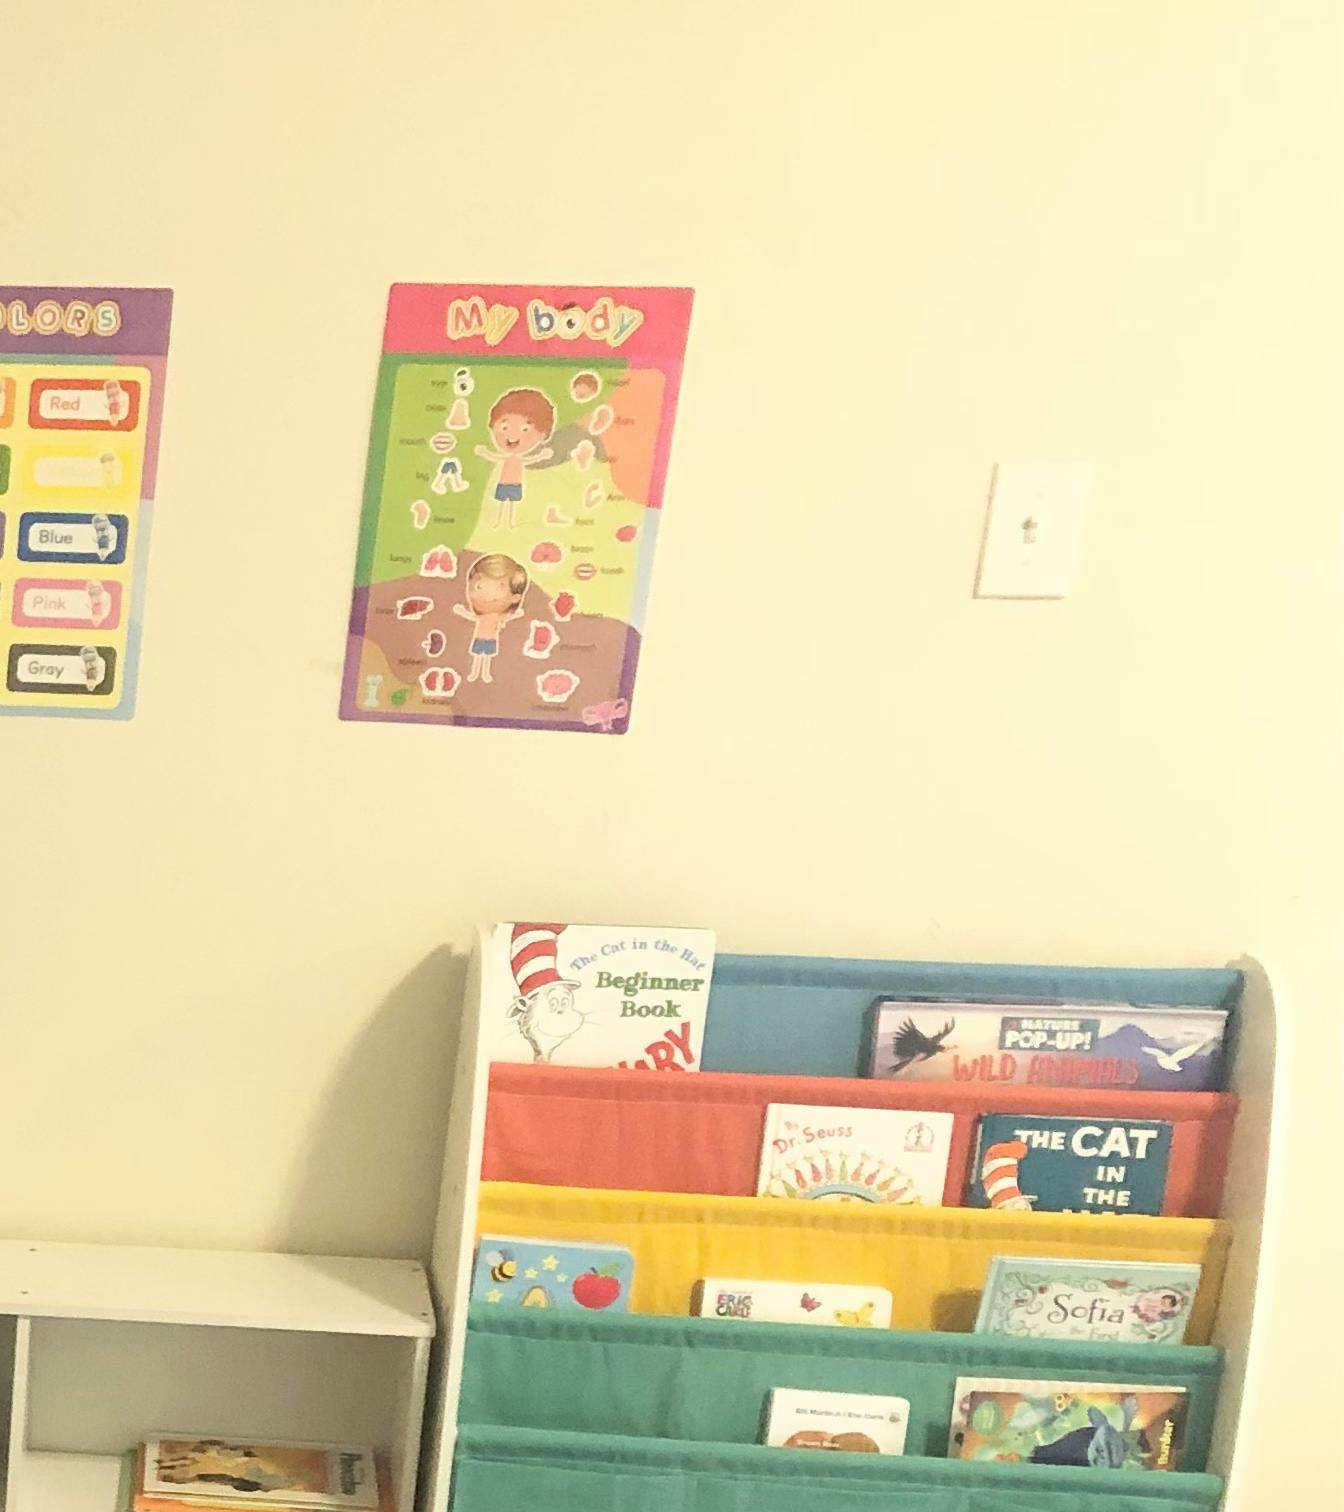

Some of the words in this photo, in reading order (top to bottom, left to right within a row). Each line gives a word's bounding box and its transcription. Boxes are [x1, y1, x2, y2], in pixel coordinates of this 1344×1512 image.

[450, 298, 518, 345] My
[529, 298, 642, 346] body
[50, 396, 80, 411] Red
[39, 530, 73, 545] Blue
[32, 596, 66, 610] Pink
[27, 661, 64, 678] Gray
[569, 952, 598, 973] The
[600, 940, 626, 957] Cat
[631, 937, 648, 950] in
[653, 938, 679, 954] the
[680, 948, 706, 972] Hat
[595, 971, 704, 997] Beginner
[620, 1000, 681, 1018] Book
[1004, 1030, 1092, 1050] POP-UP!
[953, 1054, 1017, 1082] WILD
[802, 1124, 854, 1144] Seuss
[1014, 1129, 1065, 1151] THE
[1071, 1125, 1158, 1159] CAT
[1096, 1166, 1126, 1183] IN
[1083, 1187, 1131, 1207] THE
[1047, 1293, 1125, 1324] Sofia
